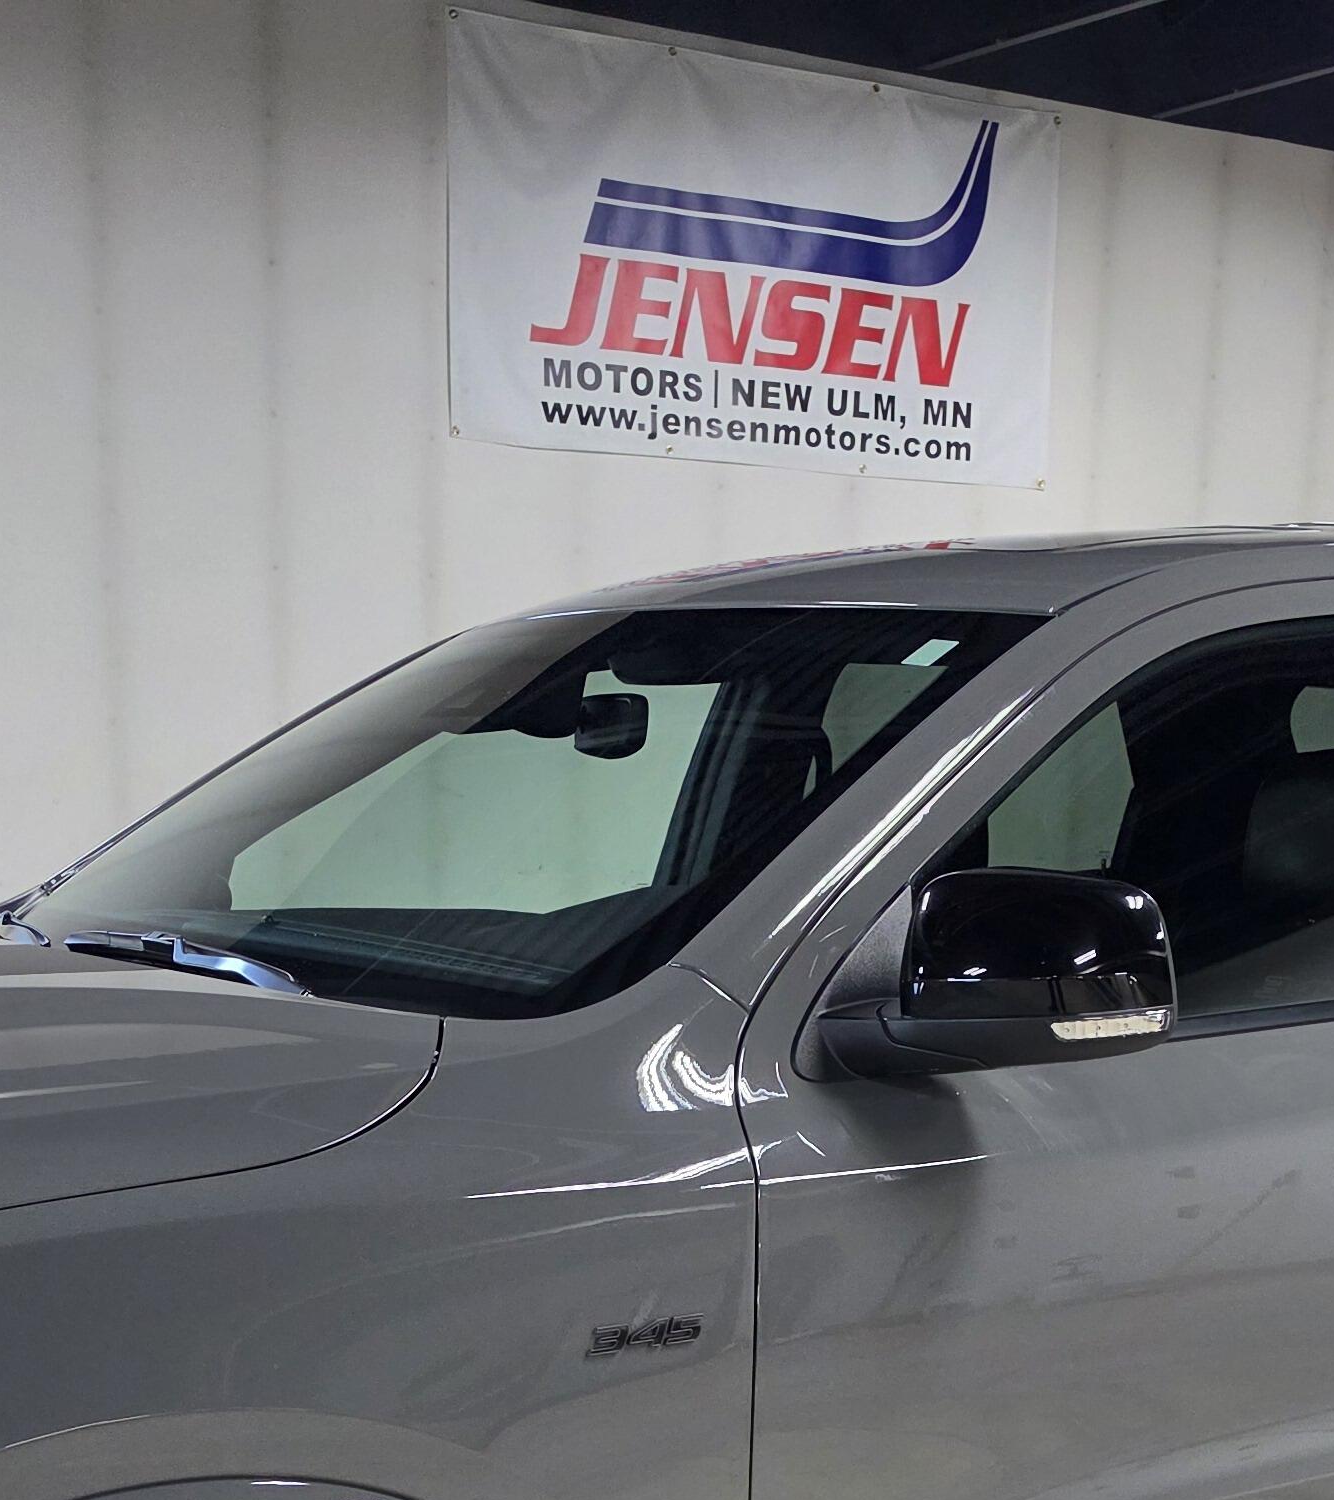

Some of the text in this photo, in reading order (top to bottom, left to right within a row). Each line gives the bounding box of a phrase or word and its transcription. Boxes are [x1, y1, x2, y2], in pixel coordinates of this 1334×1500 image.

[530, 254, 971, 387] JENSEN
[543, 358, 973, 429] MOTORS NEW ULM, MN
[541, 400, 973, 462] www.jensenmotors.com
[586, 1313, 705, 1358] 345
